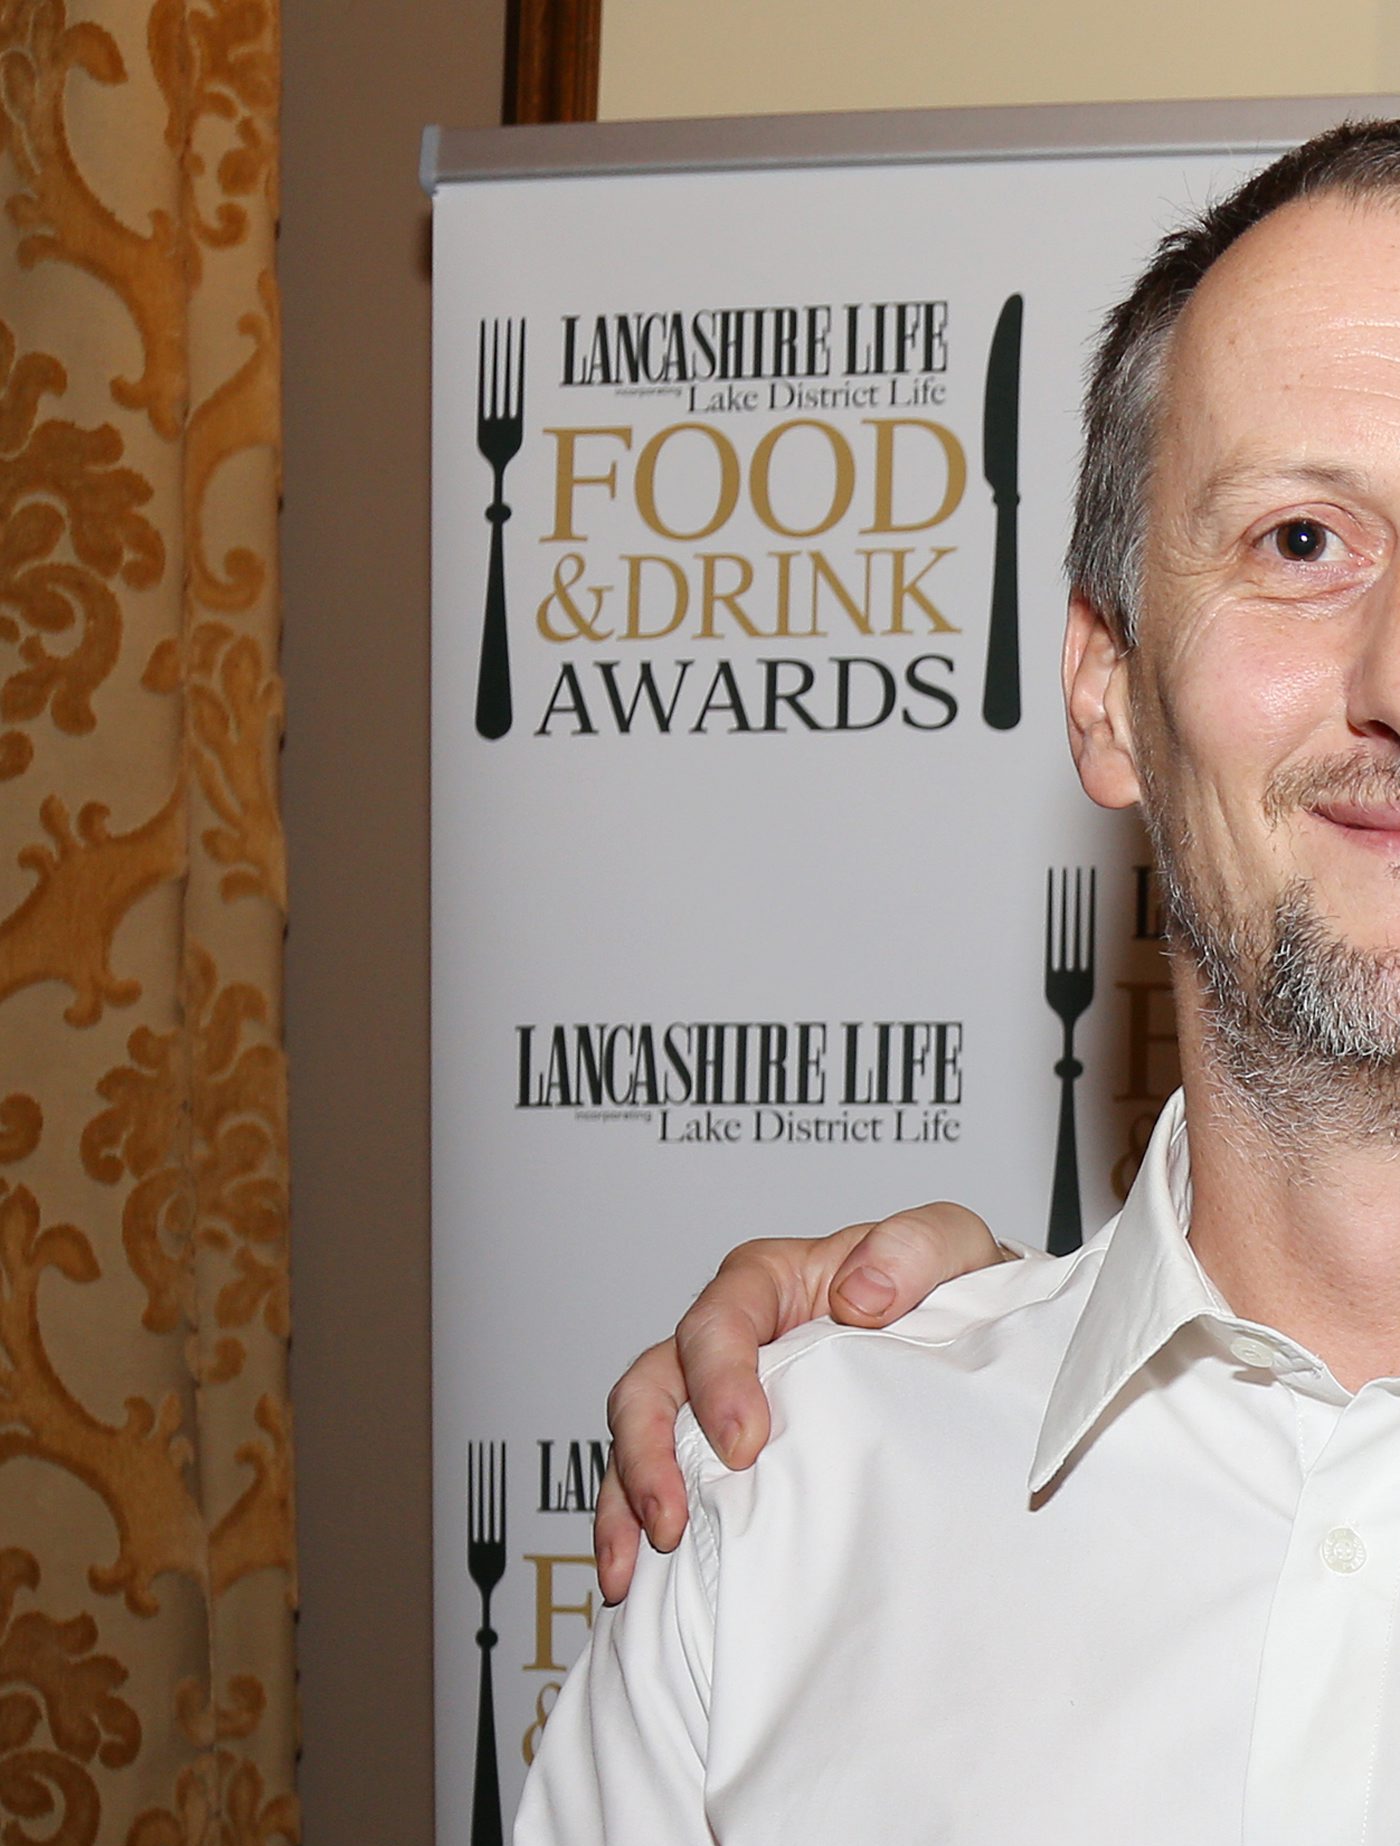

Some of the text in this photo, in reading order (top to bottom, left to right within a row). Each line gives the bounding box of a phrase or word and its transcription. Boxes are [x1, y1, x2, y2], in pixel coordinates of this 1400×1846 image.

[560, 301, 948, 387] LANCASHIRE LIFE
[687, 376, 946, 413] Lake District Life
[539, 417, 968, 544] FOOD
[535, 547, 963, 644] &DRINK
[533, 654, 958, 737] AWARDS
[514, 1021, 963, 1109] LANCASHIRE LIFE
[659, 1109, 741, 1143] Lake
[754, 1108, 884, 1143] District
[893, 1109, 960, 1142] Life
